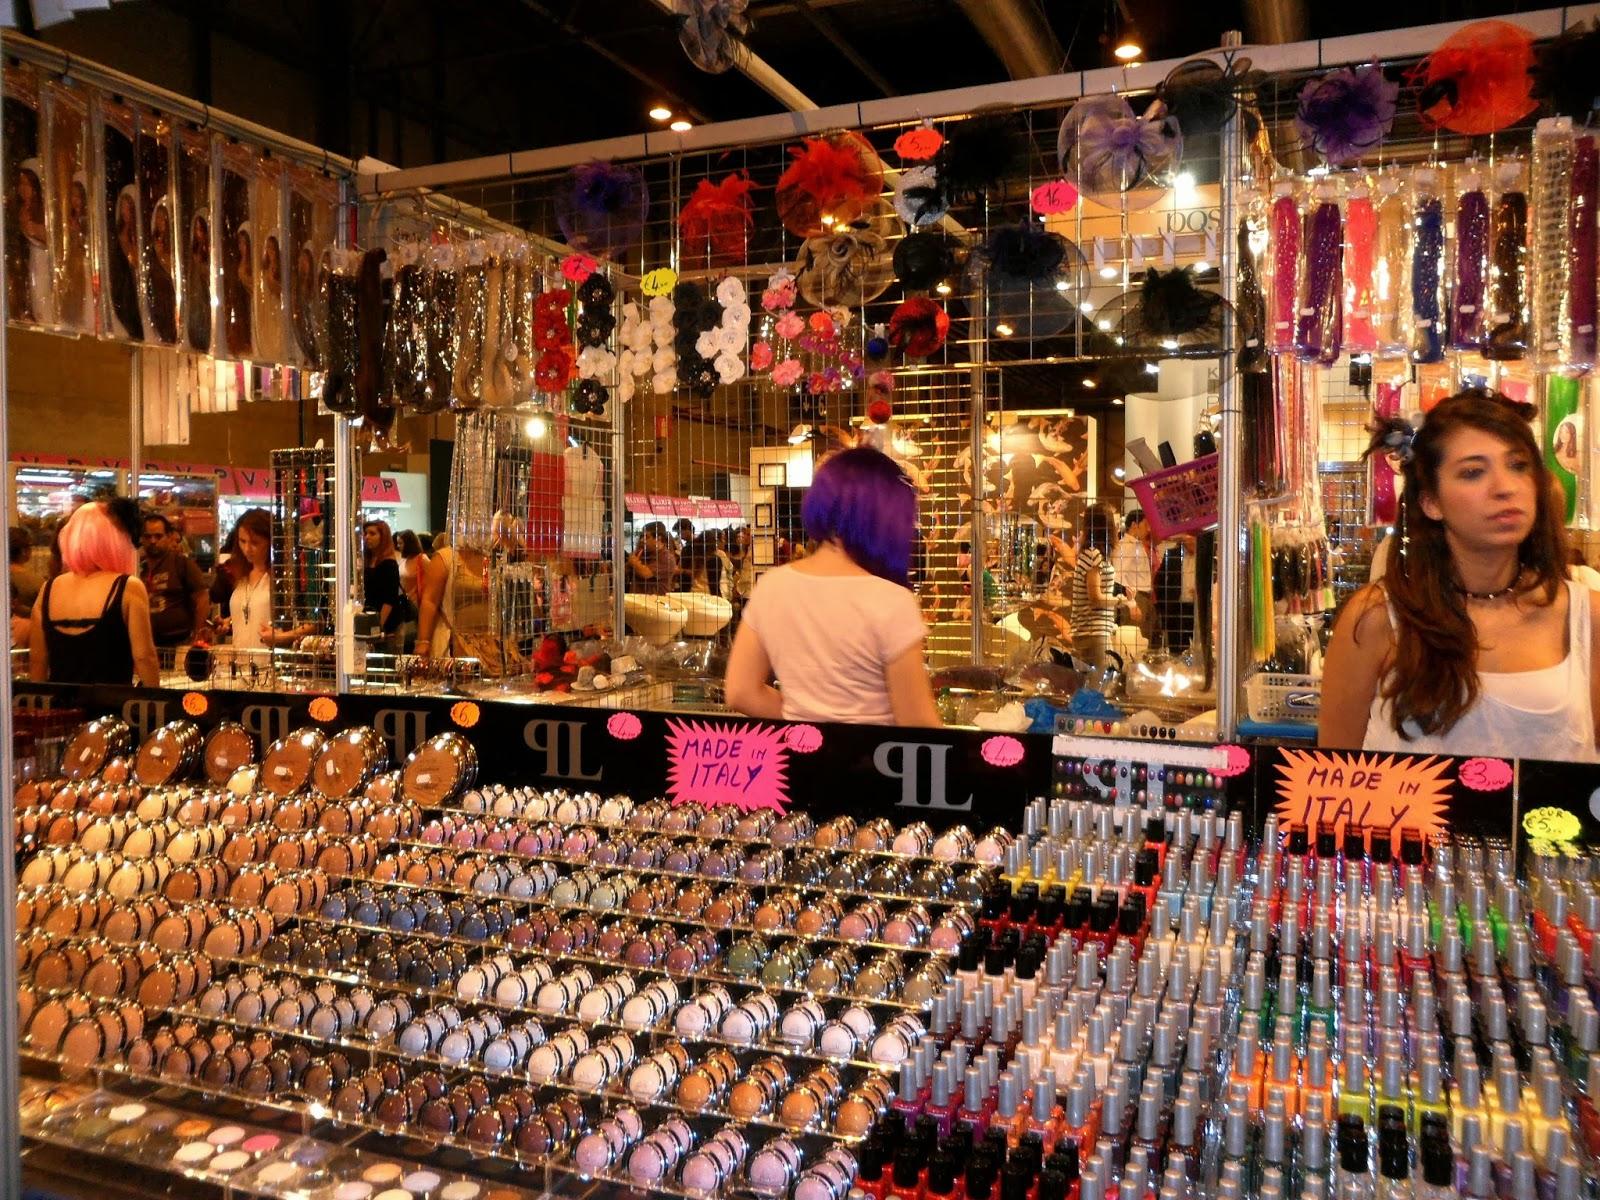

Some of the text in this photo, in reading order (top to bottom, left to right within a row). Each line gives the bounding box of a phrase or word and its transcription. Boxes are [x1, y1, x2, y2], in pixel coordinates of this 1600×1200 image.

[681, 738, 767, 760] MADE IN
[690, 762, 763, 793] ITALY
[1307, 766, 1421, 796] MADE IN
[1301, 795, 1410, 830] ITALY
